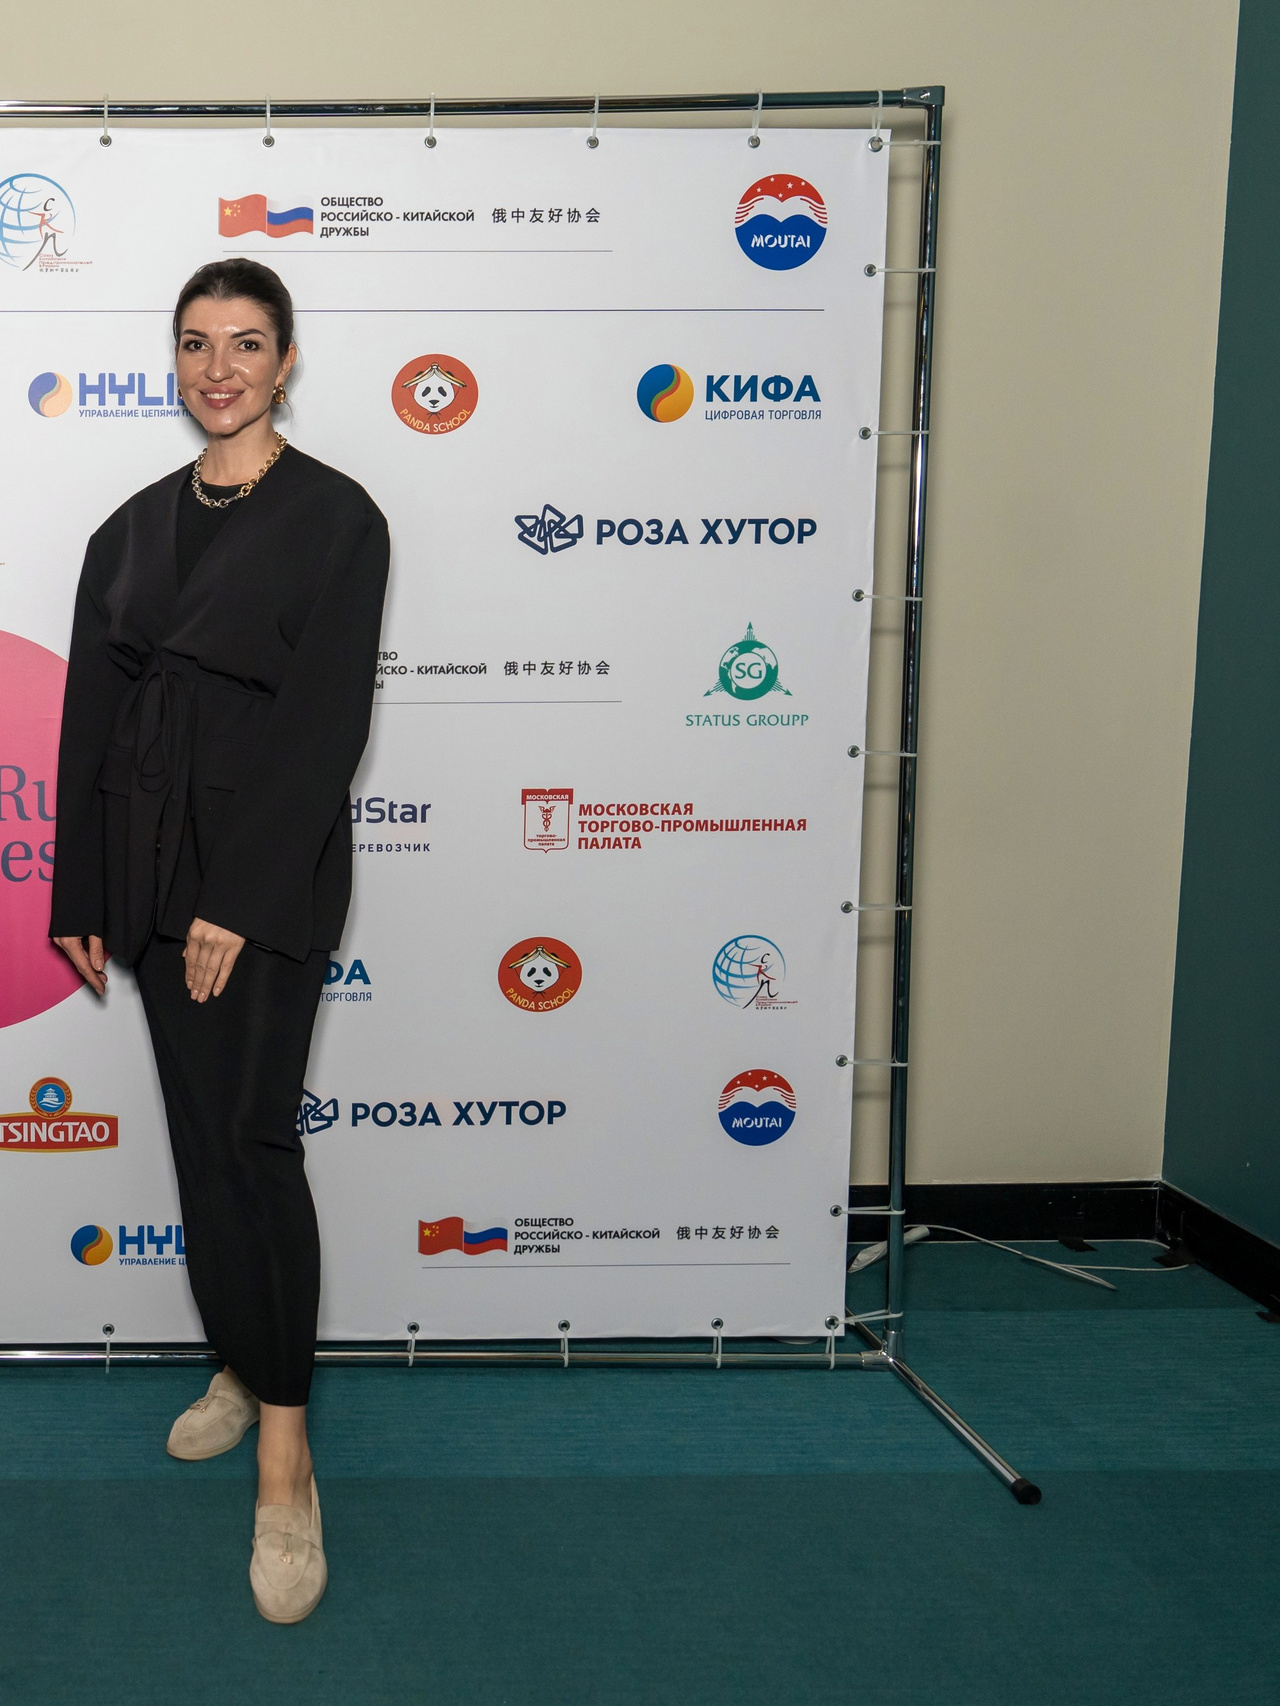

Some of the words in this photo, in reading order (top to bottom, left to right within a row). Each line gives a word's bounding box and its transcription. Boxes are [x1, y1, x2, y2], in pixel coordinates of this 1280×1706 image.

[321, 197, 383, 208] ОБЩЕСТВО
[321, 207, 393, 221] РОССИЙСКО
[403, 210, 474, 221] КИТАЙСКОЙ
[492, 208, 600, 223] 俄中友好协会
[320, 227, 369, 238] ДРУЖБЫ
[751, 235, 810, 248] MOUTAI
[78, 372, 184, 406] HYLI
[706, 375, 821, 402] КИФА
[141, 409, 181, 419] ЦЕПЯМИ
[399, 406, 430, 433] PANDA
[432, 407, 472, 433] SCHOOL
[706, 410, 764, 421] ЦИФРОВАЯ
[768, 410, 821, 419] ТОРГОВЛЯ
[597, 519, 690, 546] РОЗА
[700, 518, 817, 544] ХУТОР
[417, 663, 486, 674] КИТАЙСКОЙ
[504, 661, 610, 675] 俄中友好协会
[735, 660, 765, 681] SG
[686, 715, 740, 726] STATUS
[747, 715, 808, 726] GROUPP
[351, 797, 433, 824] dStar
[579, 803, 693, 816] МОСКОВСКАЯ
[578, 819, 806, 832] ТОРГОВО-ПРОМЫШЛЕННАЯ
[352, 843, 431, 853] ЕРЕВОЗЧИК
[578, 837, 641, 849] ПАЛАТА
[323, 959, 372, 985] ФА
[320, 992, 372, 1002] ТОРГОВЛЯ
[507, 988, 536, 1011] PANDA
[537, 987, 574, 1011] SCHOOL
[352, 1102, 442, 1127] РОЗА
[452, 1100, 566, 1125] ХУТОР
[732, 1118, 781, 1128] MOUTAI
[515, 1218, 574, 1228] ОБЩЕСТВО
[515, 1229, 583, 1240] РОССИЙСКО
[593, 1228, 660, 1239] КИТАЙСКОЙ
[677, 1225, 779, 1240] 俄中友好协会
[514, 1245, 560, 1255] ДРУЖБЫ
